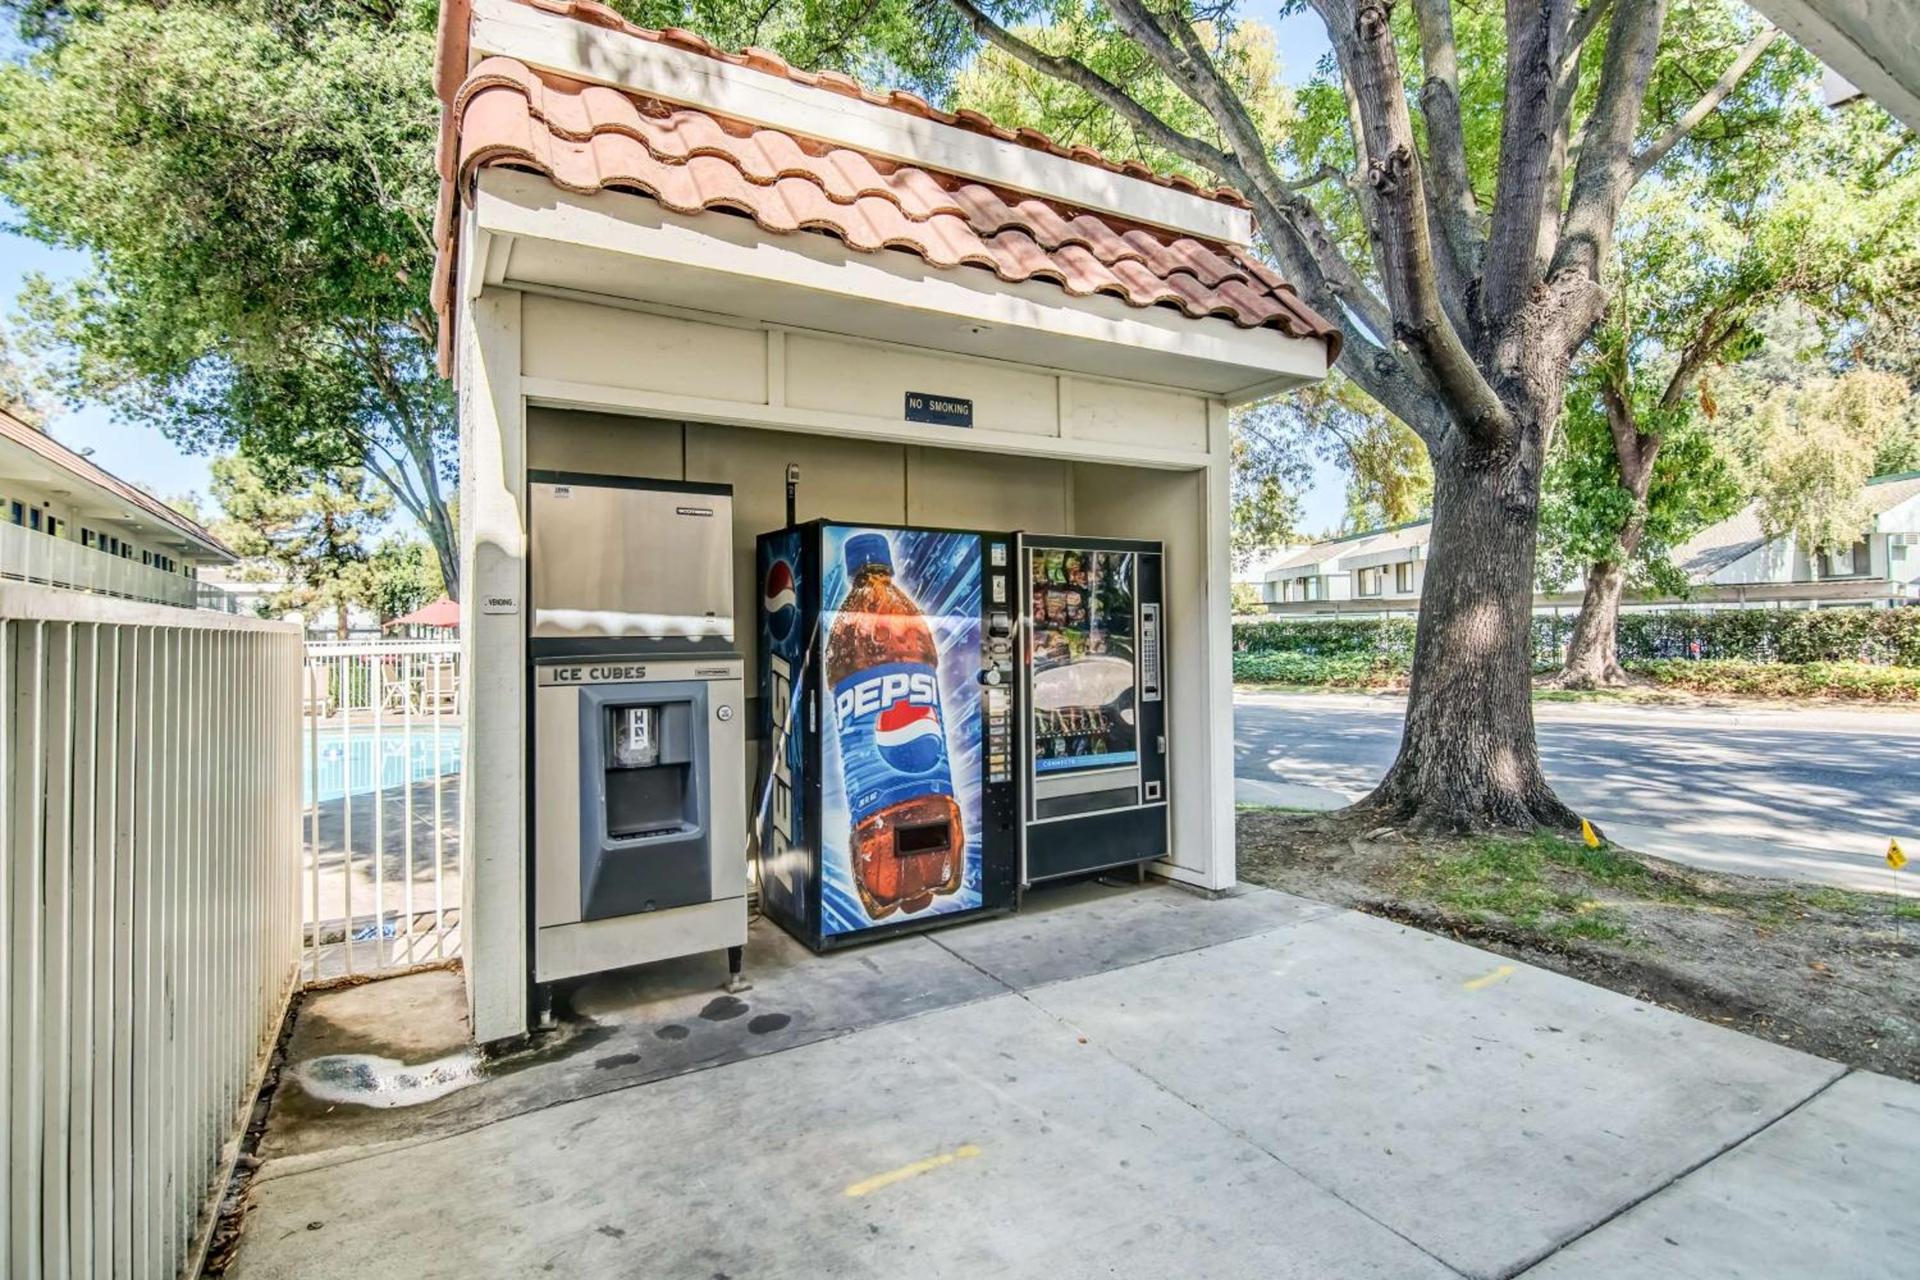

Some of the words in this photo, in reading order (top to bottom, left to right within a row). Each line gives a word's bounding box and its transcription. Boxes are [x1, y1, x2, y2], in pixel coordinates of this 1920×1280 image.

[909, 397, 923, 409] NO
[929, 400, 969, 415] SMOKING
[488, 598, 513, 606] VENDING
[553, 667, 582, 682] ICE
[589, 665, 647, 681] CUBES
[836, 672, 939, 731] PEPSI
